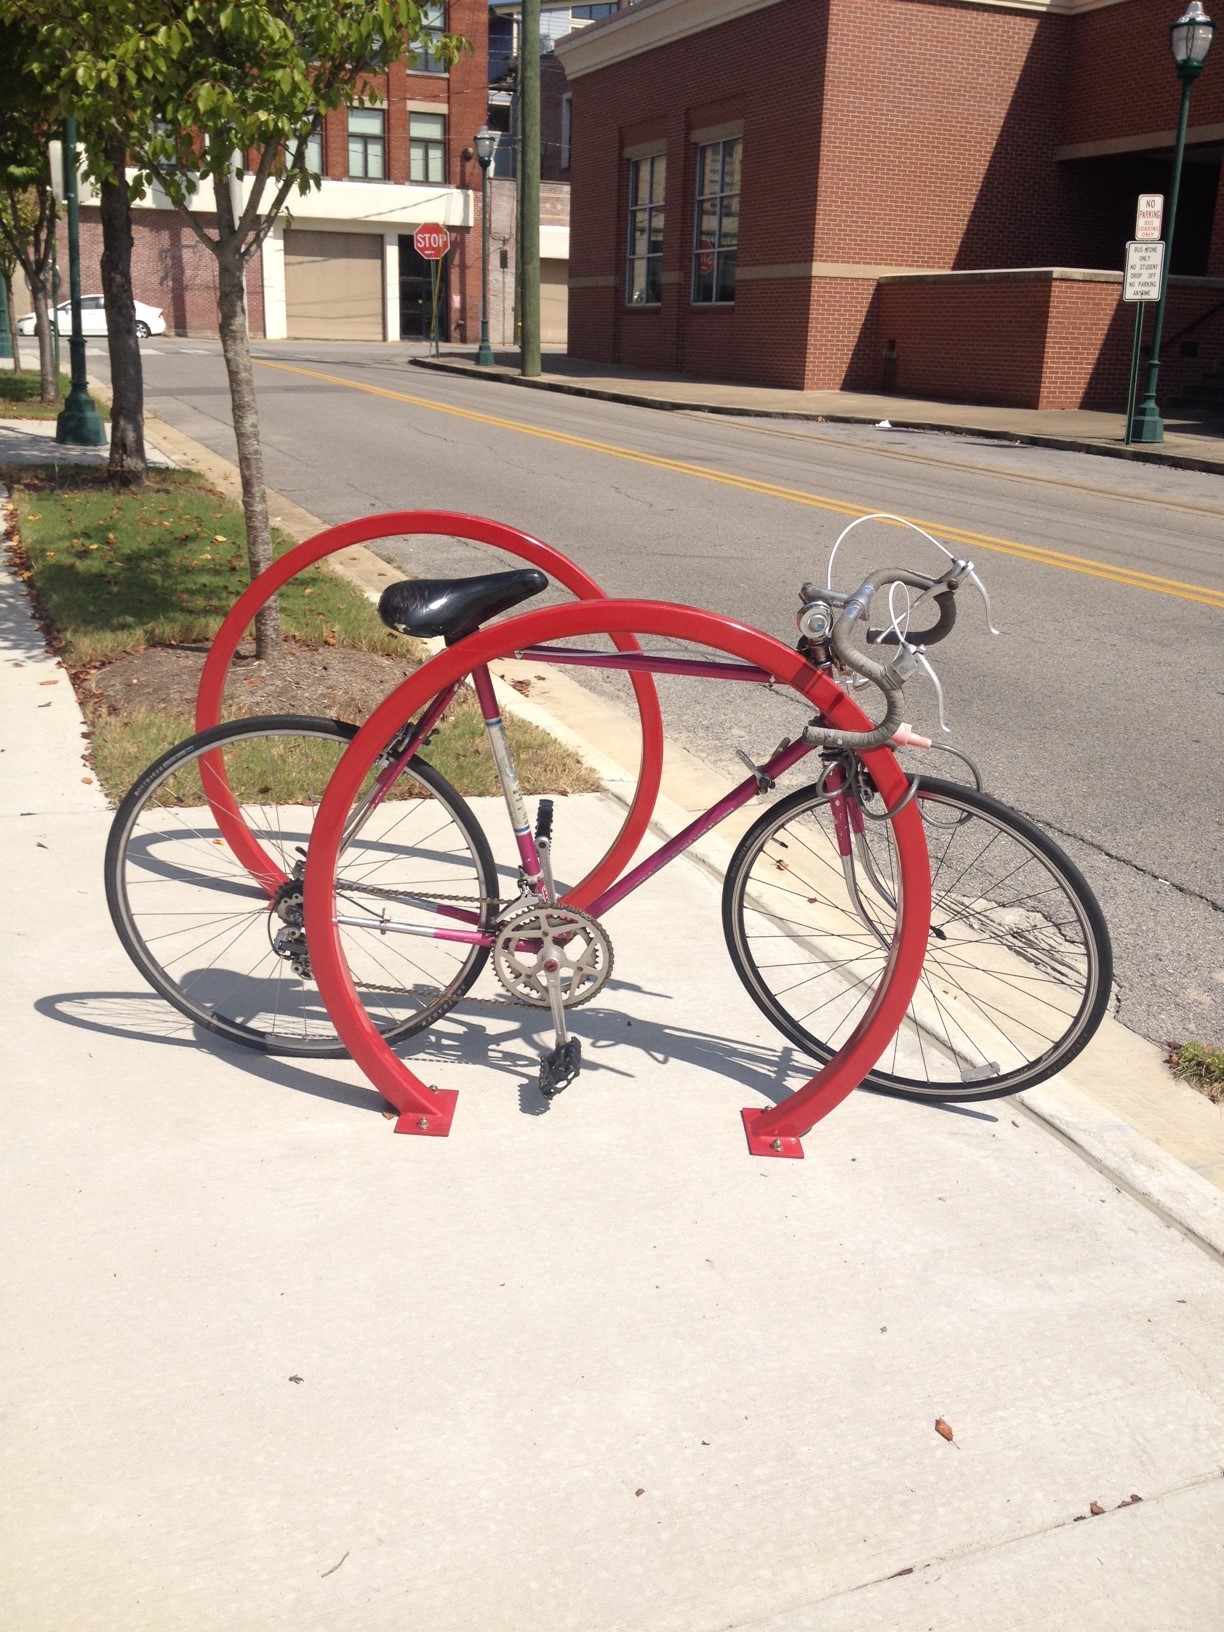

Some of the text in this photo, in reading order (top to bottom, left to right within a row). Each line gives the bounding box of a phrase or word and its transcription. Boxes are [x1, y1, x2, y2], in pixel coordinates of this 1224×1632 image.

[1146, 199, 1155, 208] NO
[1139, 210, 1160, 218] PARKING
[416, 234, 446, 248] STOP
[134, 766, 163, 796] BONTRAGER
[421, 984, 466, 1027] BOTRAGER
